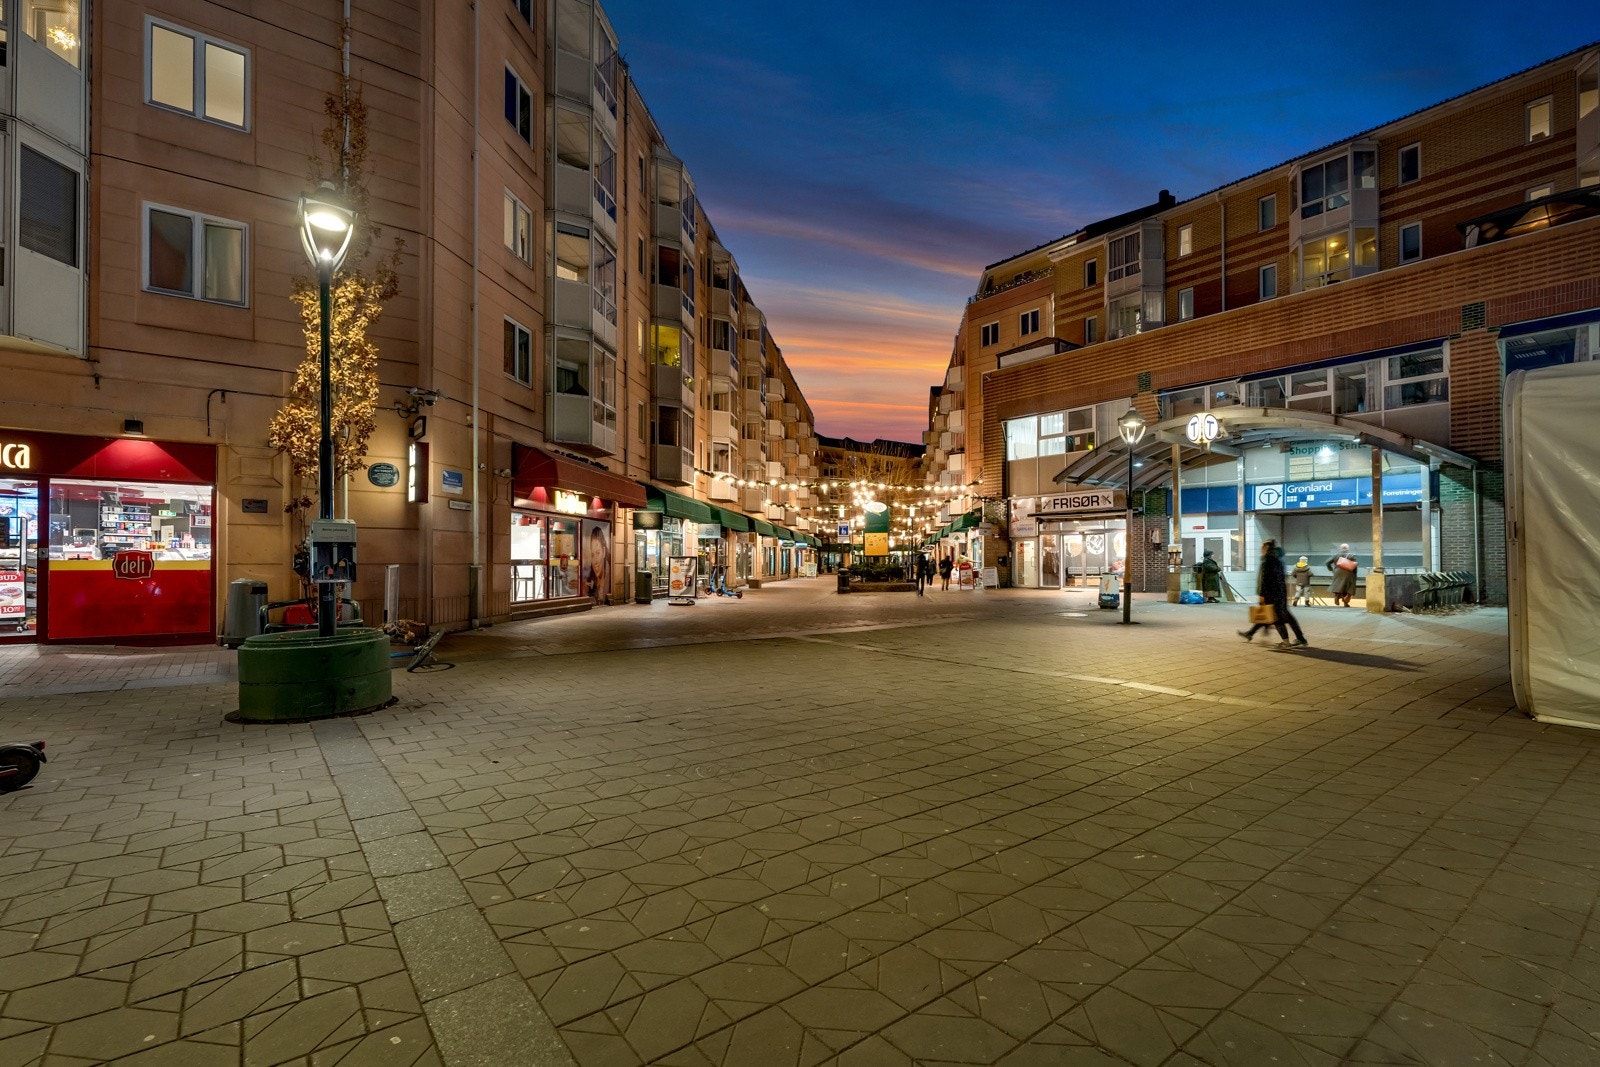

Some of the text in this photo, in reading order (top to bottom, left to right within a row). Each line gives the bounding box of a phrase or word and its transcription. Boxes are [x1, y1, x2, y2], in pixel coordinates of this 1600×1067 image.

[1190, 421, 1198, 438] T
[1206, 420, 1215, 437] T
[0, 443, 30, 469] ca
[1287, 482, 1333, 493] Grønland
[1053, 495, 1099, 509] FRISØR
[121, 555, 145, 574] deli
